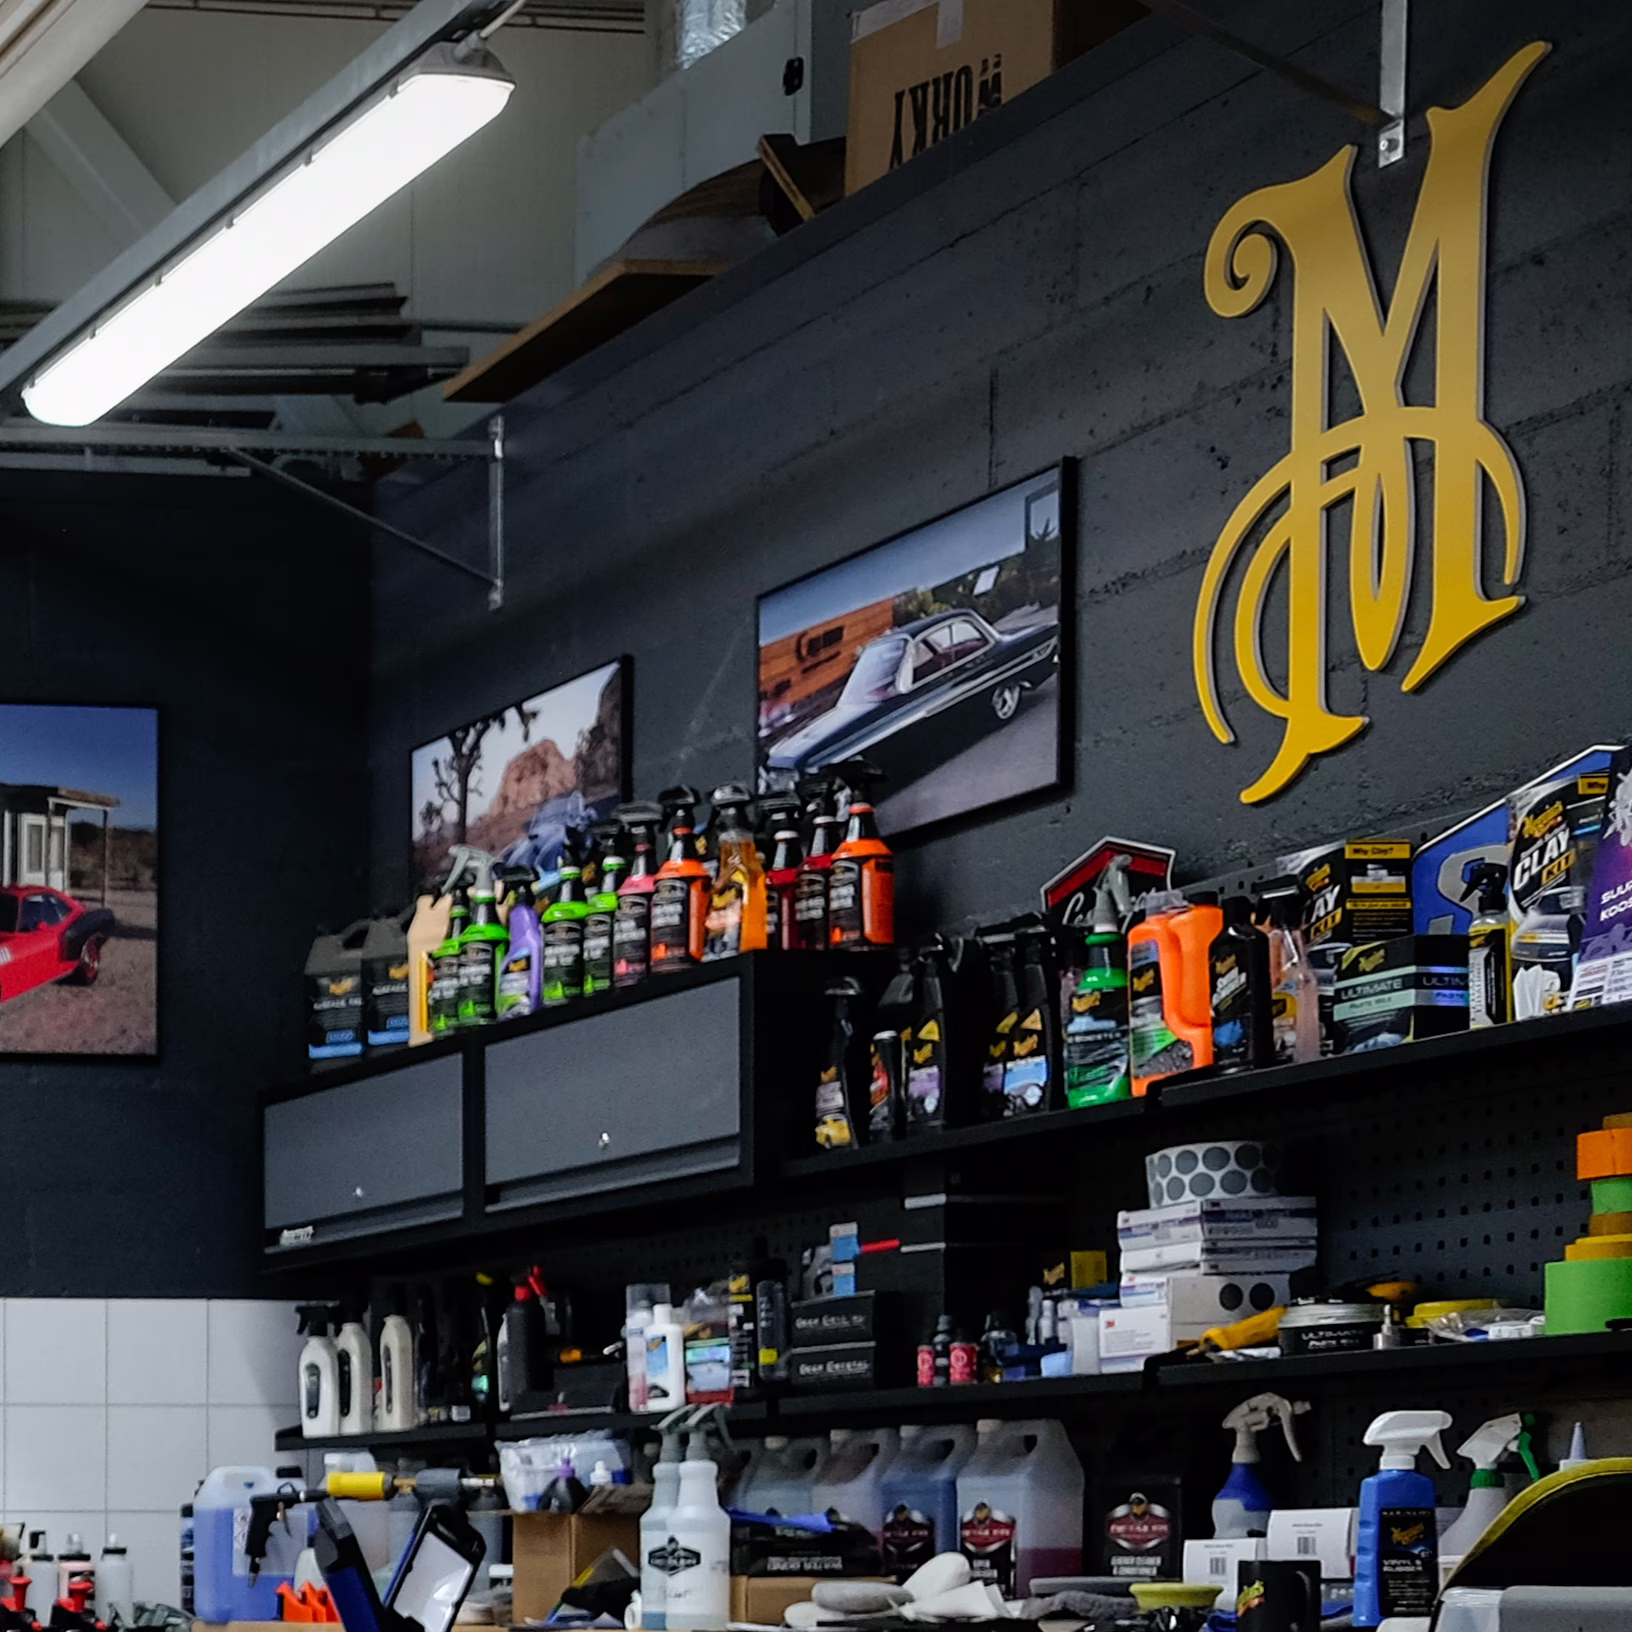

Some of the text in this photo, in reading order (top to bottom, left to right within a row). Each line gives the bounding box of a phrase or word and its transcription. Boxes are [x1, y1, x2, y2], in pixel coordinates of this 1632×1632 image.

[1513, 827, 1571, 892] CLAY
[1311, 884, 1341, 924] AY
[1341, 977, 1403, 1000] ULTIMATE
[1422, 976, 1469, 987] ULTIM
